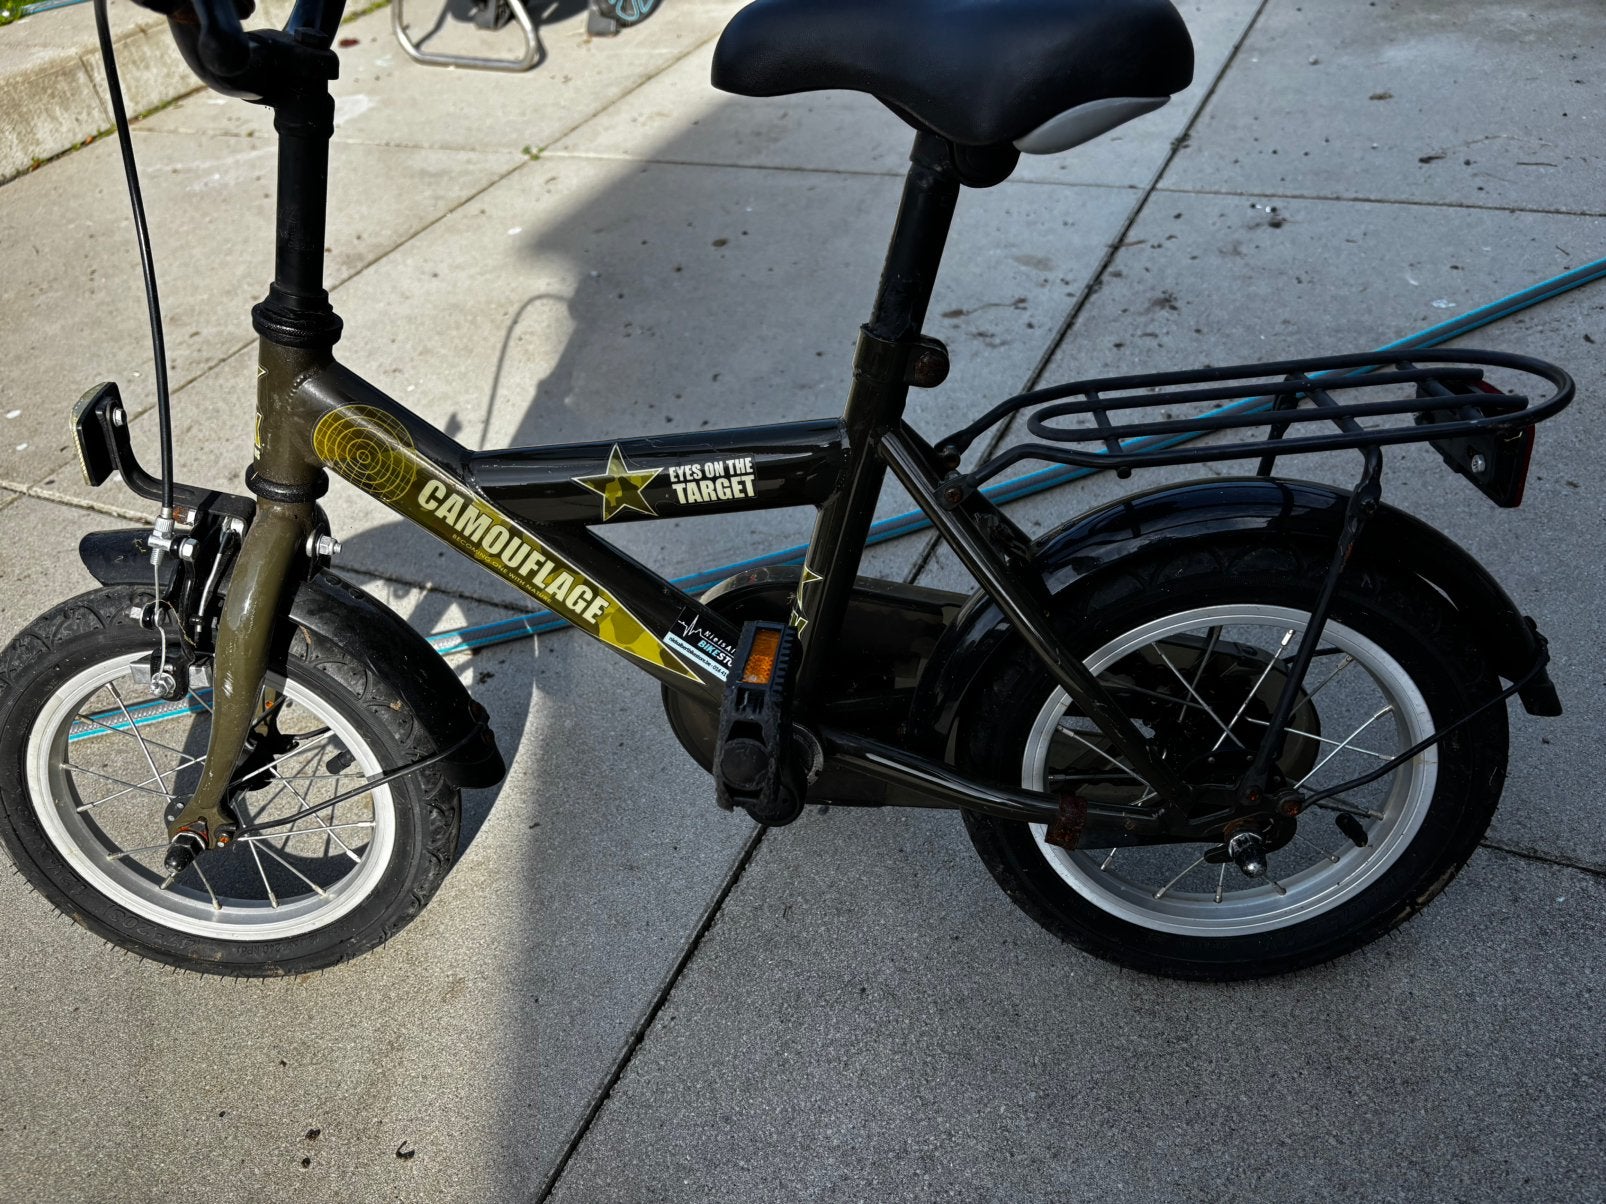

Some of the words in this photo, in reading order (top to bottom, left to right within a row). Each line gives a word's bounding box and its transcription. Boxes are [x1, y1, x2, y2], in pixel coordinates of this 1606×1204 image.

[668, 463, 702, 482] EYES
[704, 461, 725, 478] ON
[726, 457, 754, 475] THE
[672, 474, 755, 505] TARGET
[417, 479, 610, 624] CAMOUFLAGE
[452, 534, 491, 563] BECOMING
[492, 561, 508, 574] ONE
[508, 572, 526, 586] WITH
[526, 584, 552, 603] NATURE
